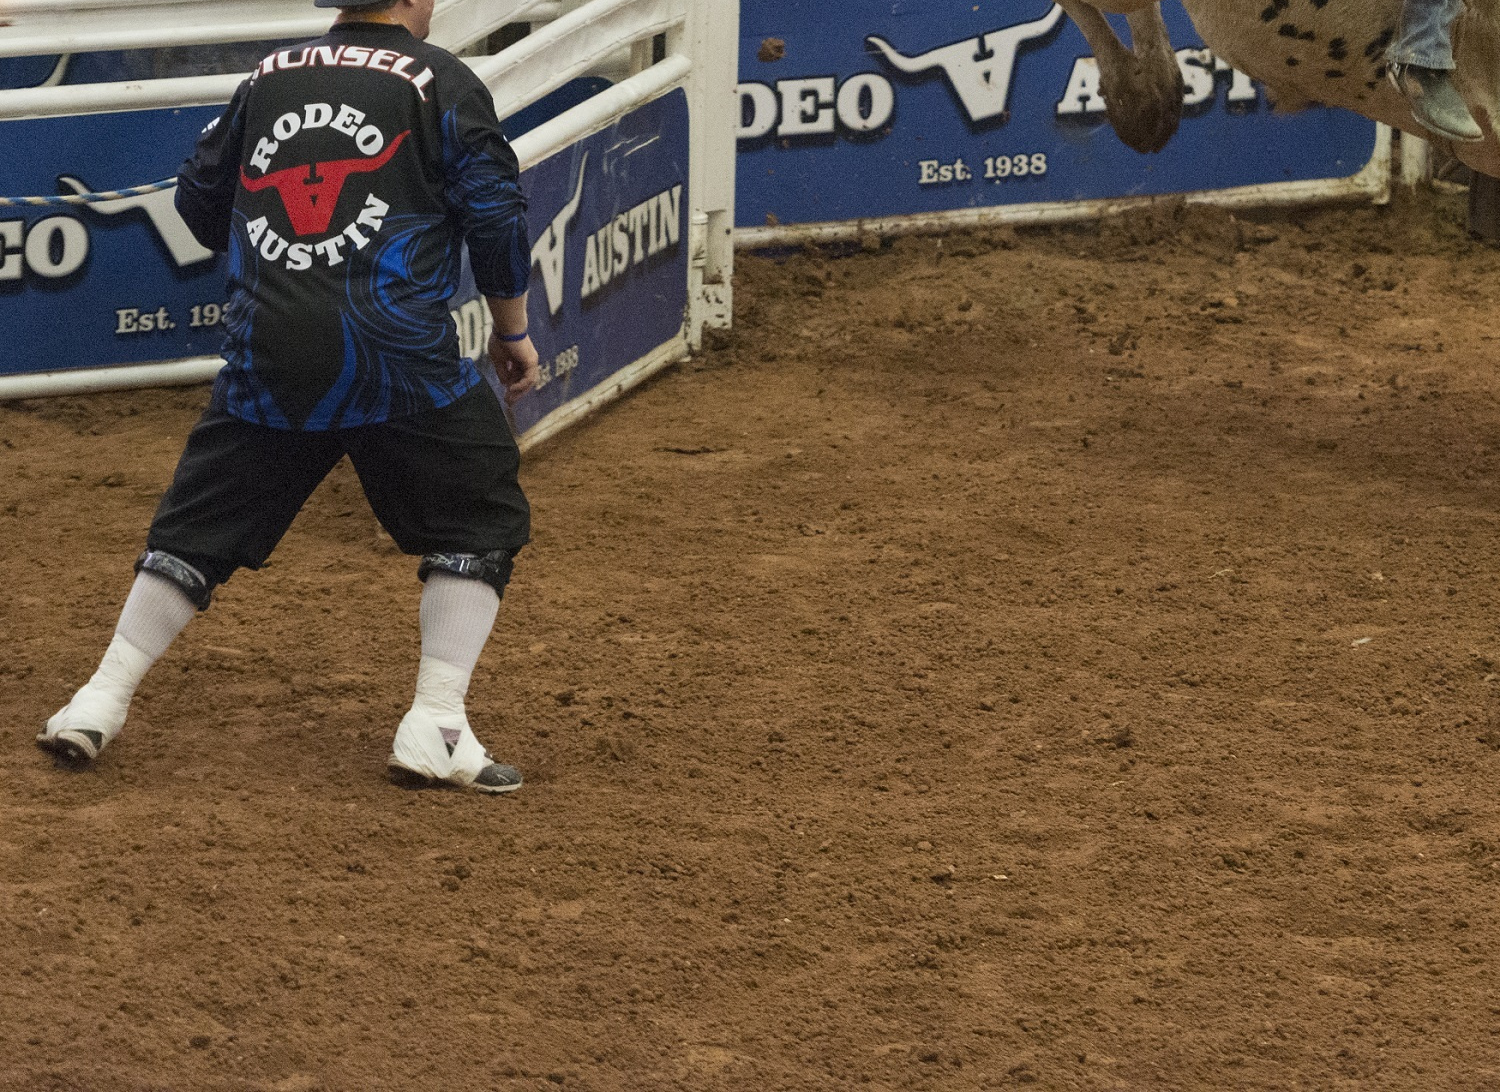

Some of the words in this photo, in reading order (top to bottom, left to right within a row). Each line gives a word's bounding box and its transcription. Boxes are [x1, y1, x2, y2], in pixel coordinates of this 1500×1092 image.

[250, 103, 384, 174] RODEO
[919, 160, 972, 184] Est.
[983, 154, 1047, 179] 1938
[246, 193, 390, 271] AUSTIN
[581, 184, 682, 299] AUSTIN
[115, 308, 176, 334] Est.
